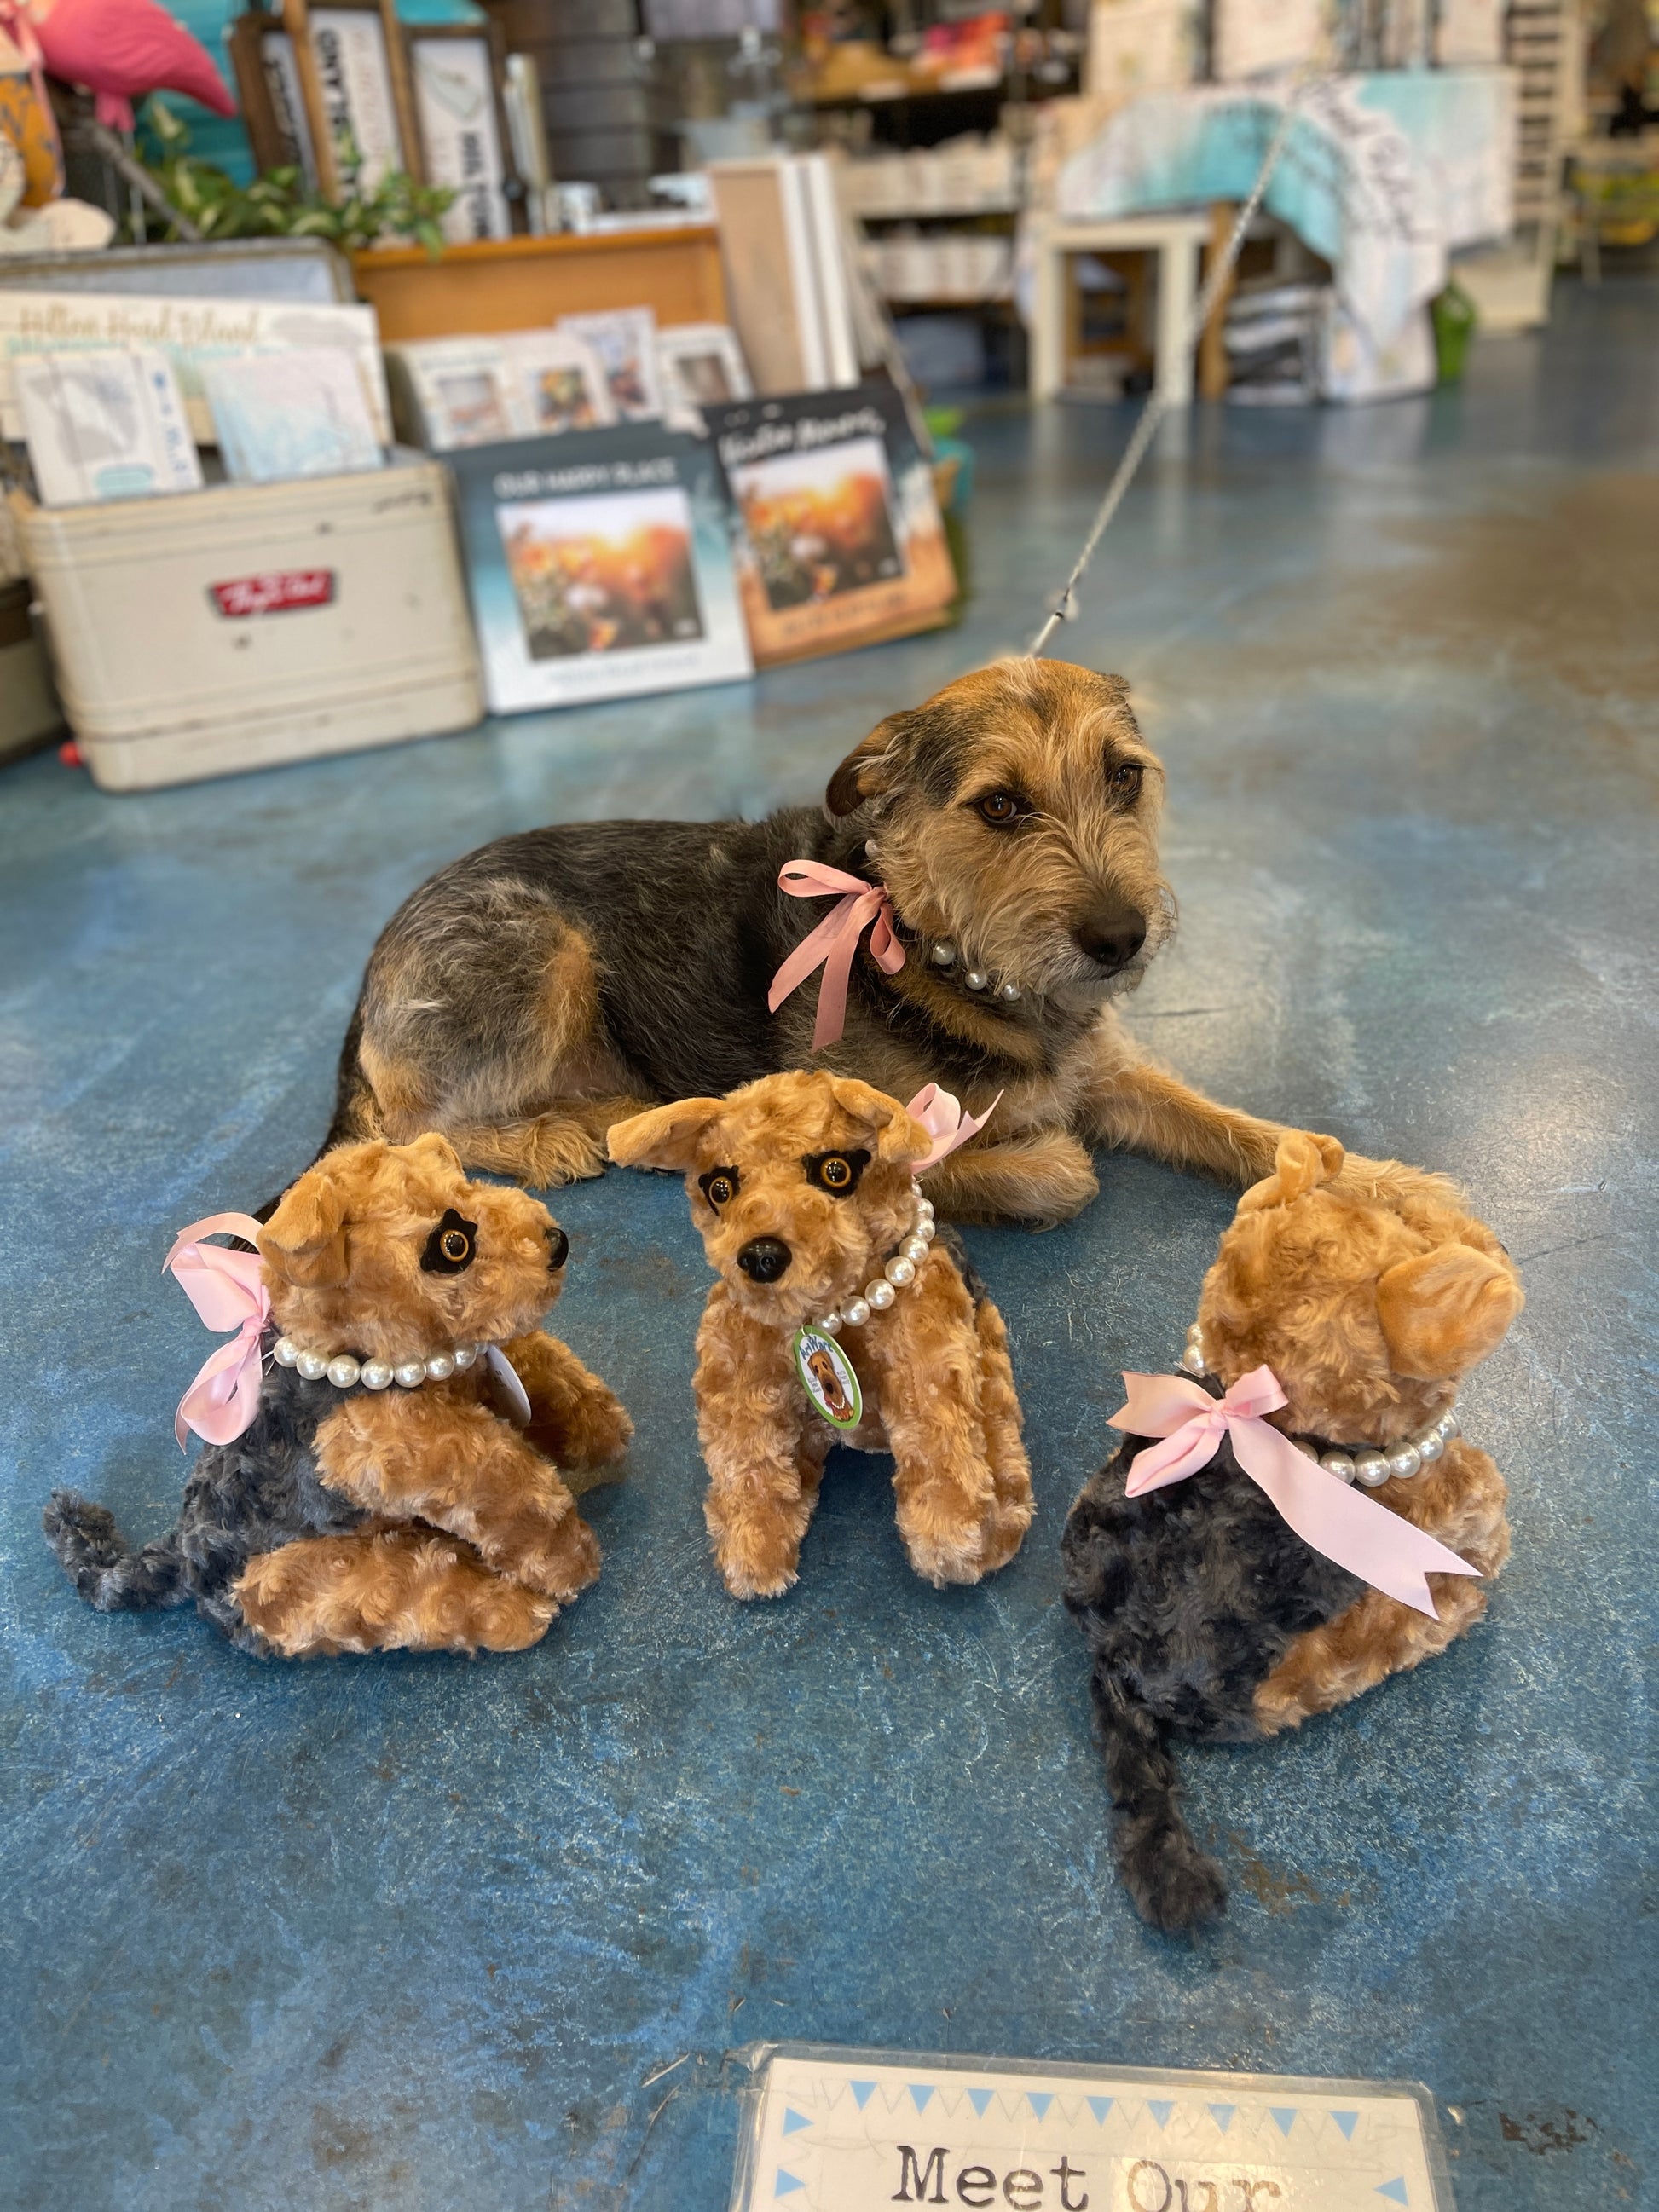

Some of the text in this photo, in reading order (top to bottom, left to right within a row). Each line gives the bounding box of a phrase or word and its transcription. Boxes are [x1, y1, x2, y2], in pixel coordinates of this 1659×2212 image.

[493, 470, 541, 499] OUR
[891, 2146, 1281, 2212] Meet Our
